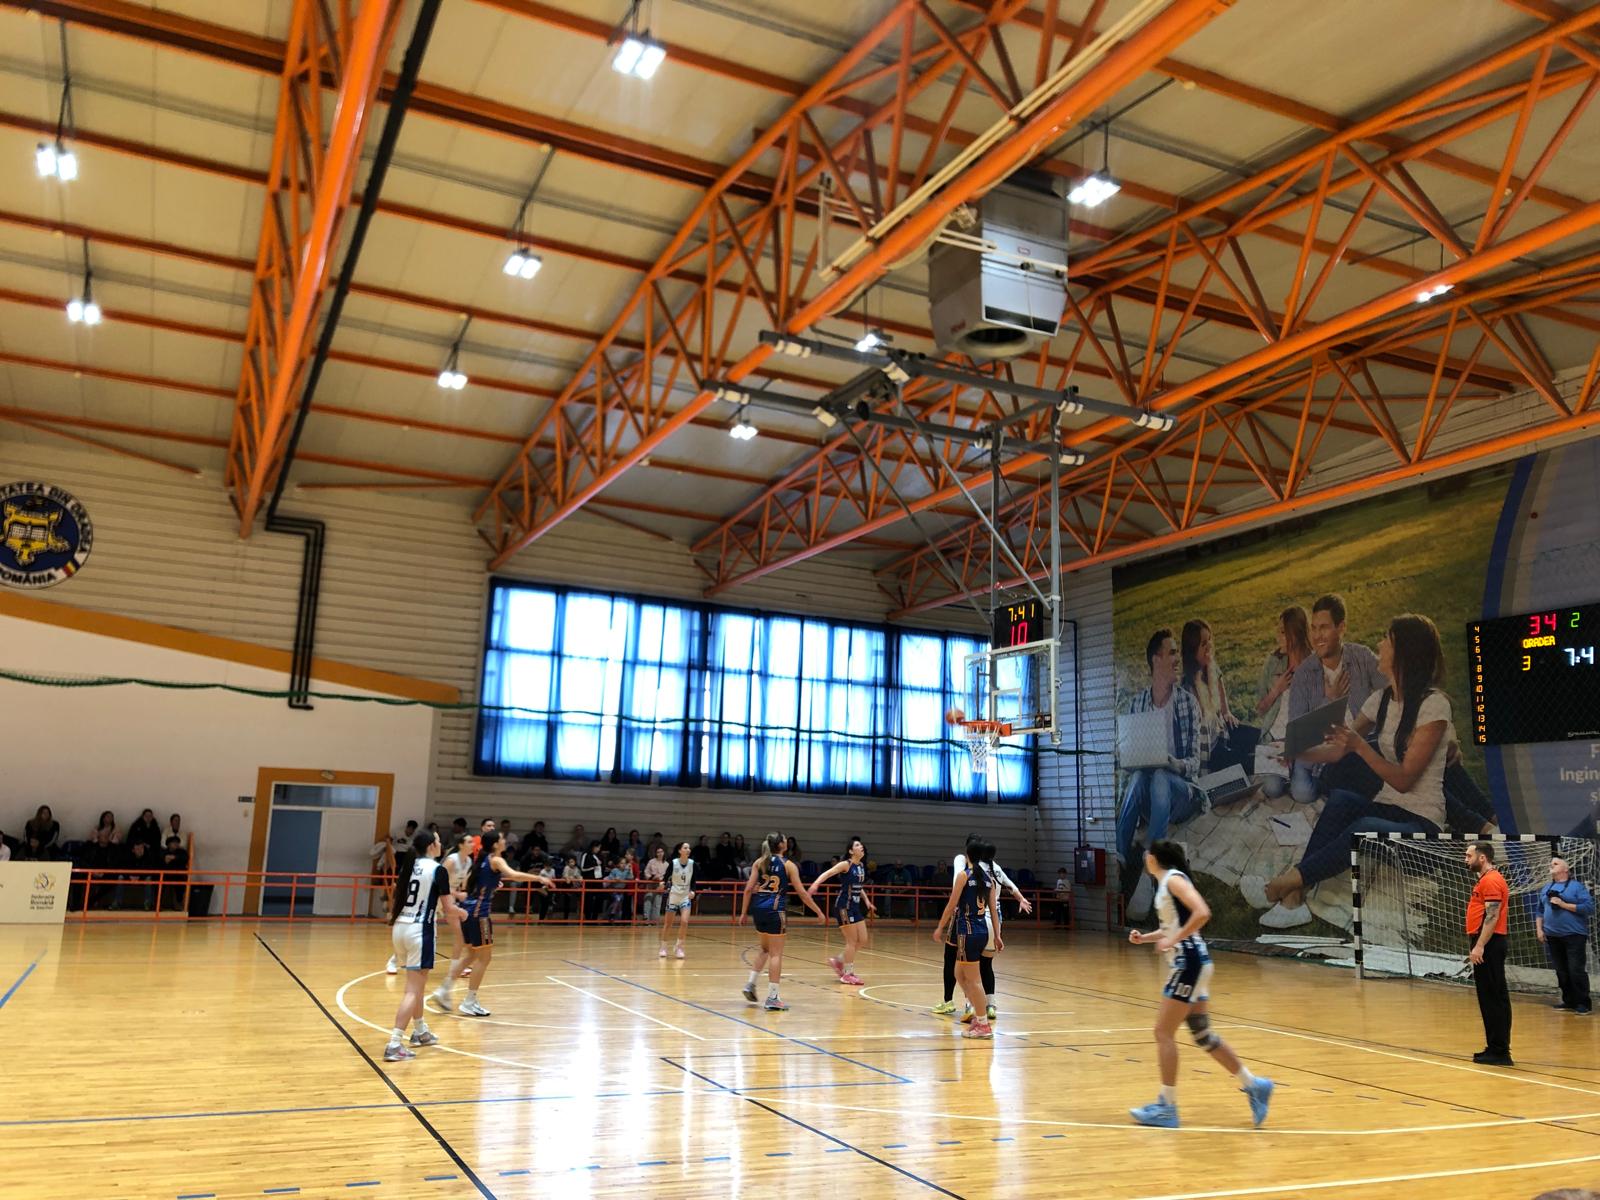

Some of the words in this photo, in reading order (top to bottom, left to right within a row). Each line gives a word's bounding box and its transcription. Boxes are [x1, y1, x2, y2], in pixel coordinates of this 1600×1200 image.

[0, 567, 57, 584] OMÂNIA
[1530, 613, 1557, 635] 34
[1570, 612, 1580, 628] 2
[1011, 622, 1027, 649] 10
[1521, 655, 1531, 671] 3
[1477, 675, 1483, 683] 9
[1476, 685, 1483, 693] 10
[1479, 735, 1487, 743] 15
